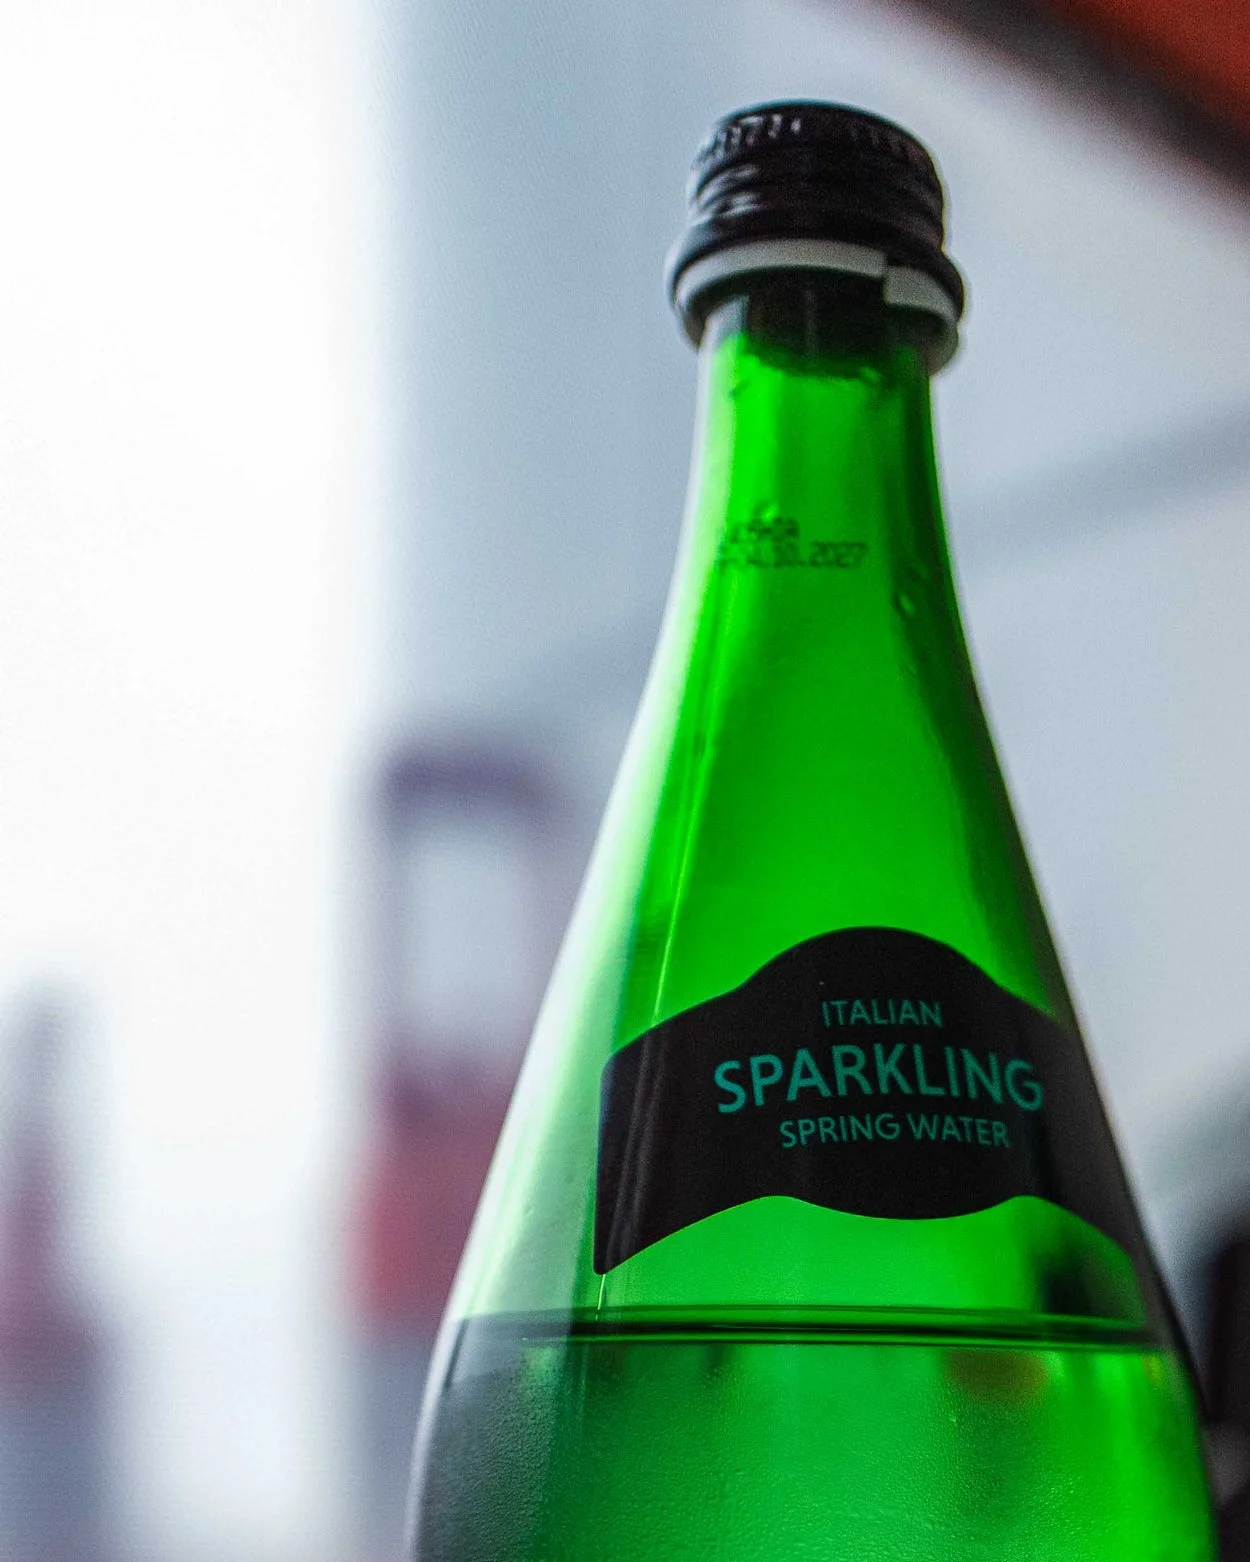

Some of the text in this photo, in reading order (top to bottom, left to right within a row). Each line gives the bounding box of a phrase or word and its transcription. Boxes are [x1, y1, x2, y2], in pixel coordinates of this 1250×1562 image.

[822, 1000, 943, 1028] ITALIAN
[713, 1042, 1044, 1113] SPARKLING
[779, 1113, 1010, 1149] SPRING WATER
